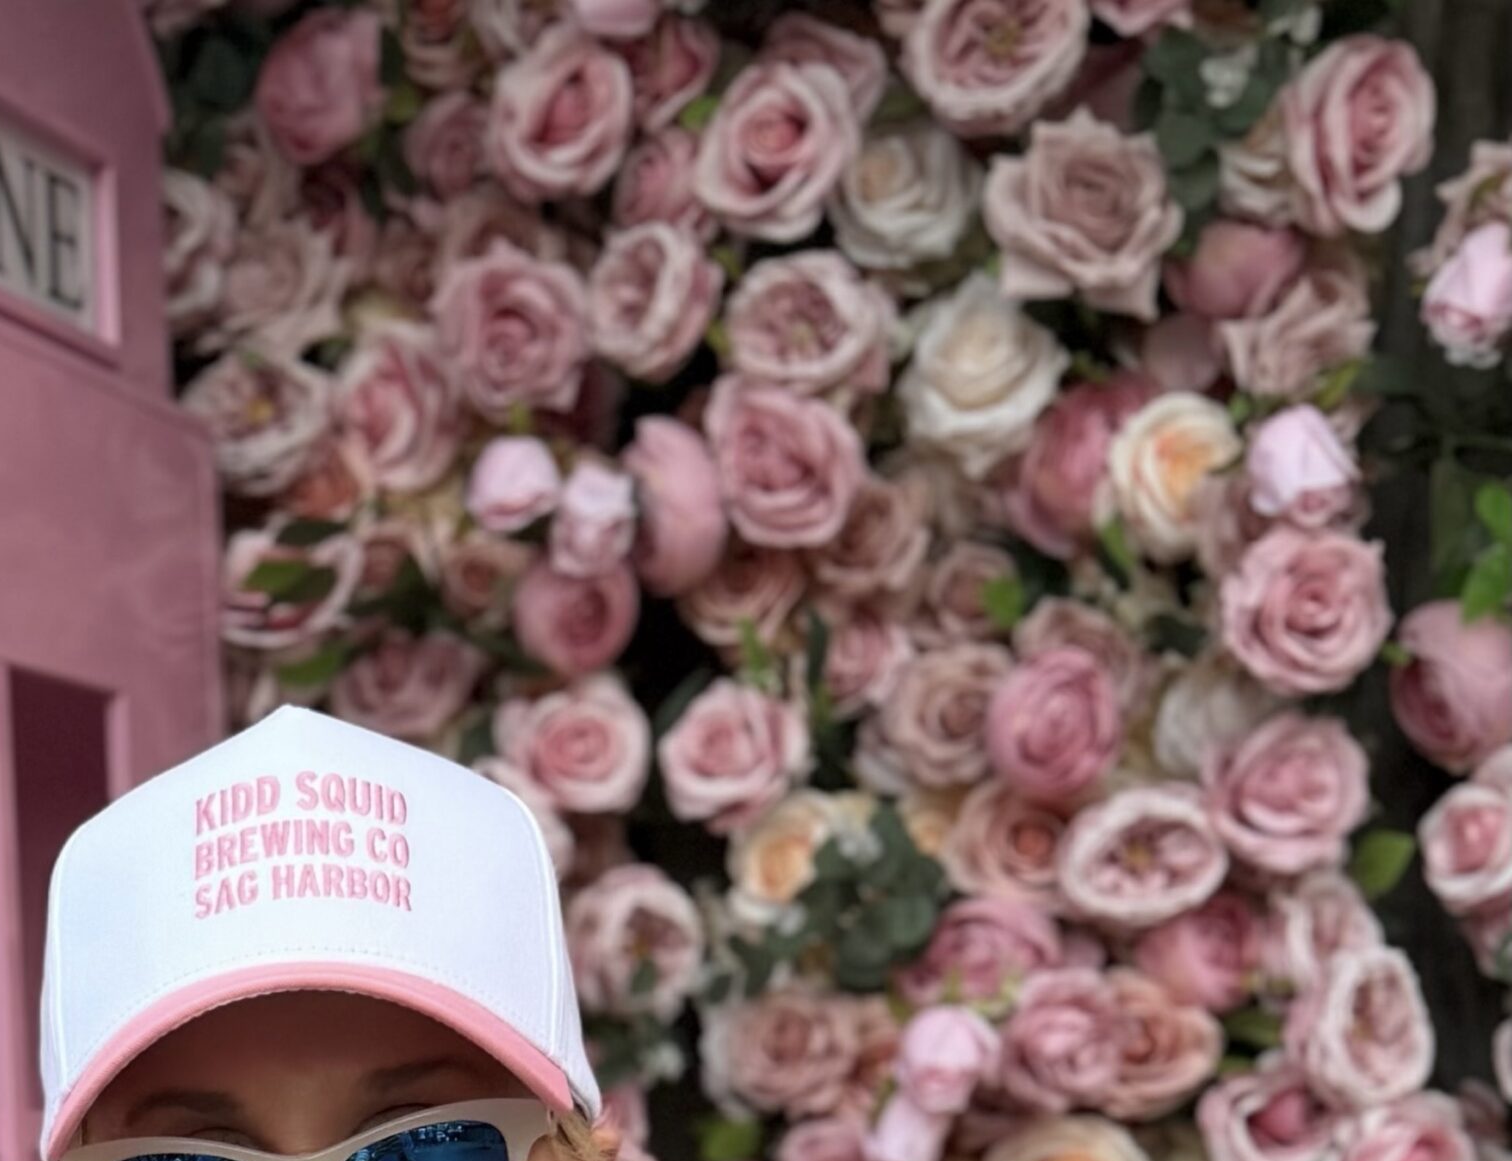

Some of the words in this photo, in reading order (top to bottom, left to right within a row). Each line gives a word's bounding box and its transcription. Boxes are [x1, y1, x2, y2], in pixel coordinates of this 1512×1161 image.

[194, 775, 282, 837] KIDD
[294, 770, 408, 826] SQUID
[194, 819, 356, 881] BREWING
[365, 827, 411, 869] CO
[194, 870, 260, 919] SAG
[271, 863, 413, 912] HARBOR
